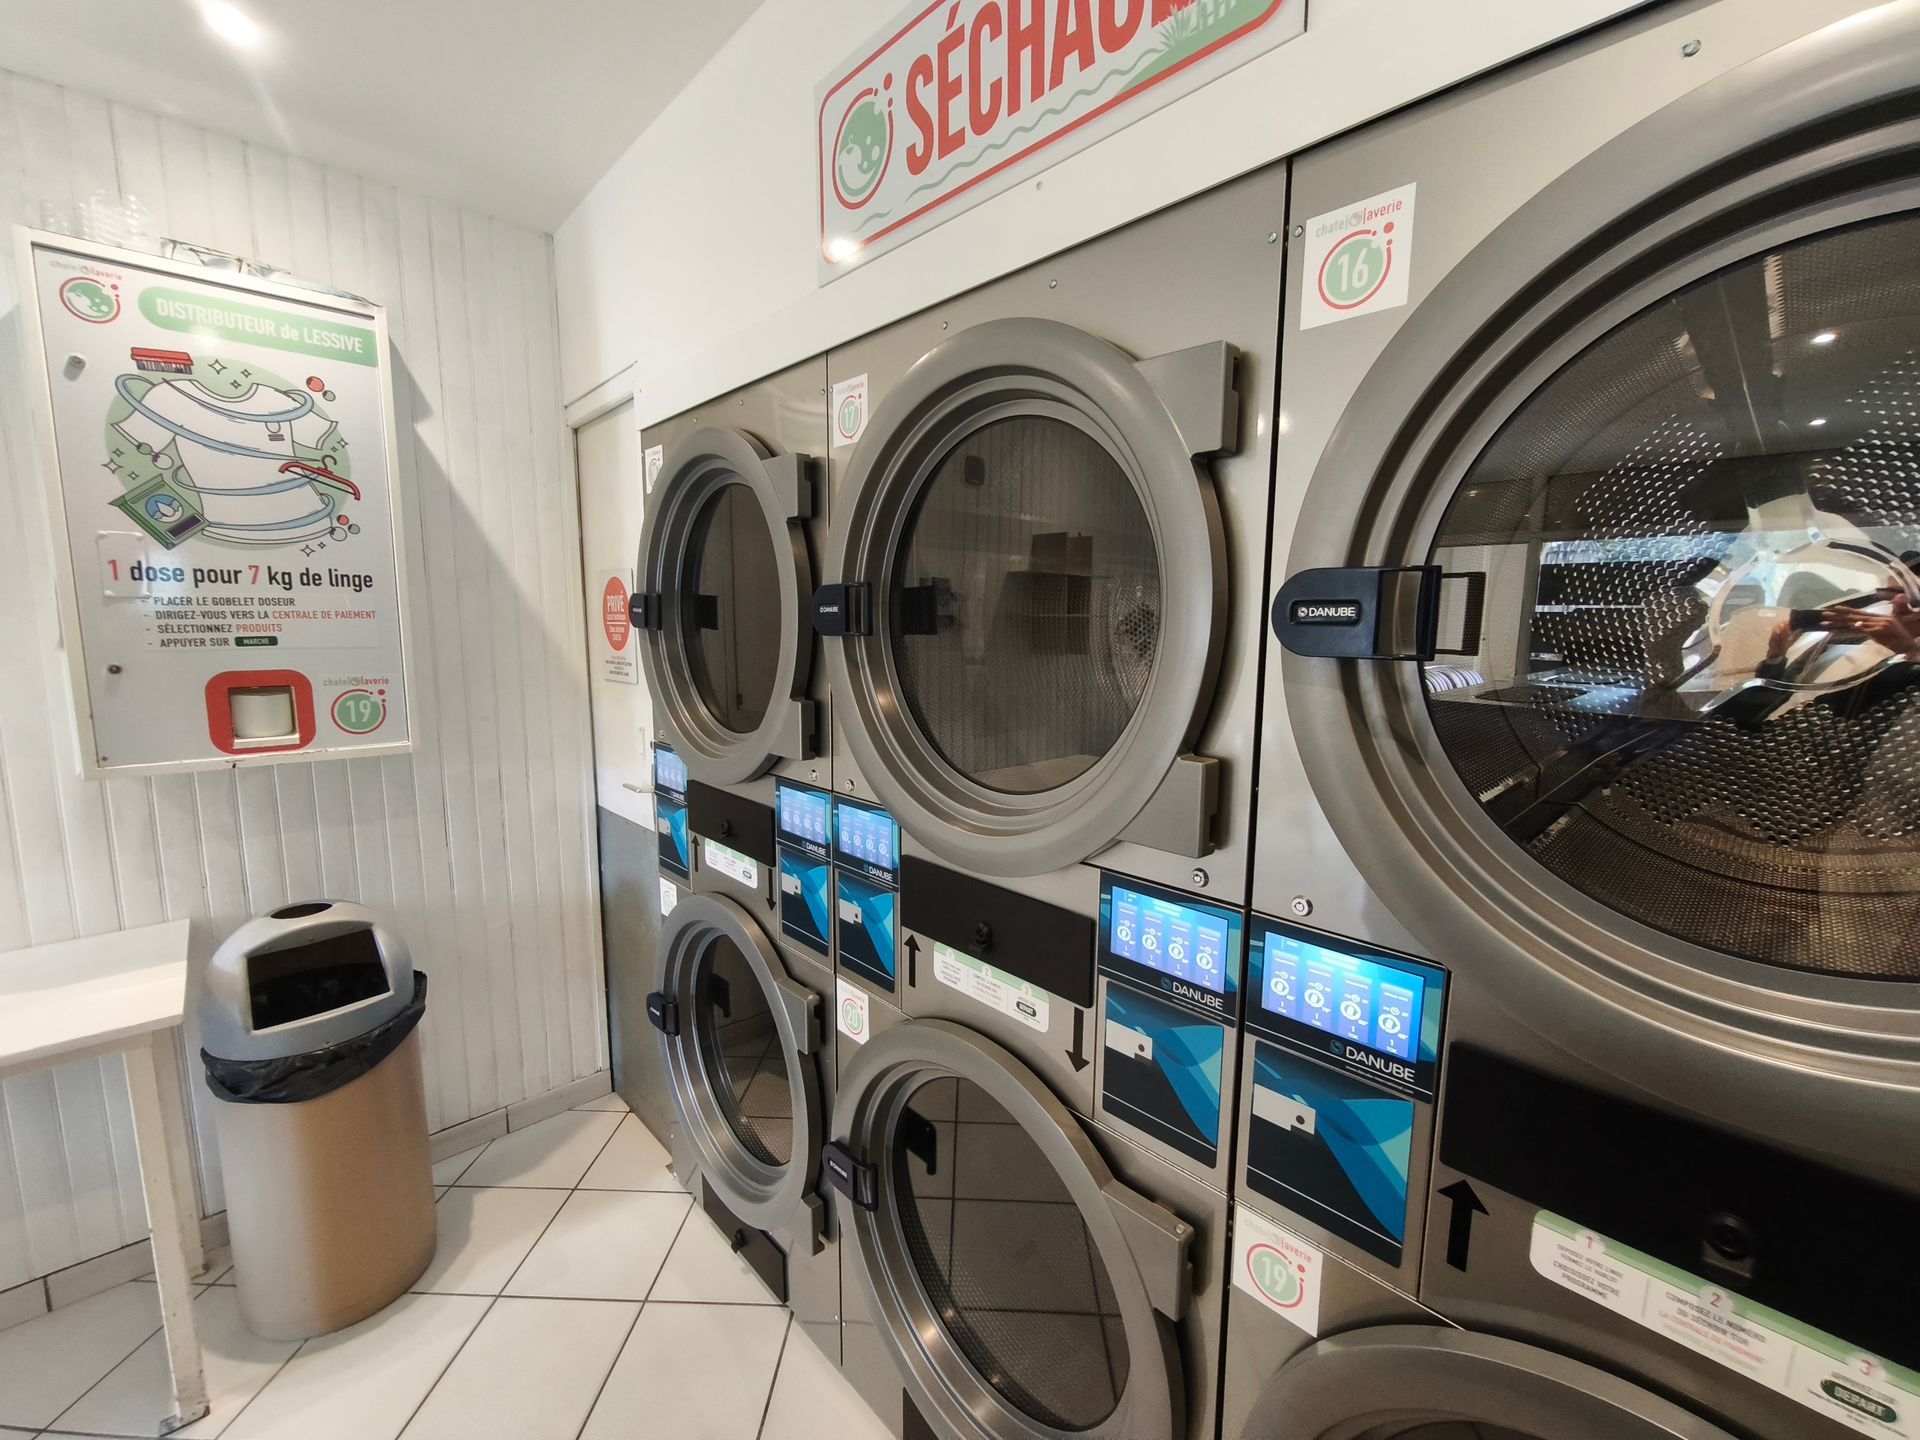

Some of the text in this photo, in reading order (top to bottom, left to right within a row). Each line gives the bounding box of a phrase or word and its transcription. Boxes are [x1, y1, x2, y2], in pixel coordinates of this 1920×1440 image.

[906, 0, 1200, 176] SÉCHA
[1315, 199, 1402, 238] chatel laverie
[1337, 247, 1369, 293] 16
[156, 297, 364, 354] DISTRIBUTEUR de LESSIVE
[107, 559, 373, 593] 1 dose pour 7 kg de linge
[154, 596, 296, 607] PLACER LE GOBELET DOSEUR
[155, 610, 376, 620] DIRIGEZ-VOUS VERS LA CENTRALE DE PAIEMENT
[1308, 606, 1356, 618] DANUBE
[236, 623, 283, 634] PRODUITS
[160, 638, 207, 648] APPUYER
[209, 637, 230, 648] SUR
[361, 675, 390, 686] laverie
[345, 699, 372, 723] 19
[806, 842, 827, 857] DANUBE
[868, 866, 893, 882] DANUBE
[1172, 981, 1224, 1010] DANUBE
[1345, 1046, 1416, 1083] DANUBE
[1281, 1237, 1312, 1263] laverie
[1585, 1233, 1594, 1249] 1
[1261, 1256, 1288, 1293] 19
[1709, 1292, 1722, 1308] 2
[1859, 1358, 1873, 1376] 3
